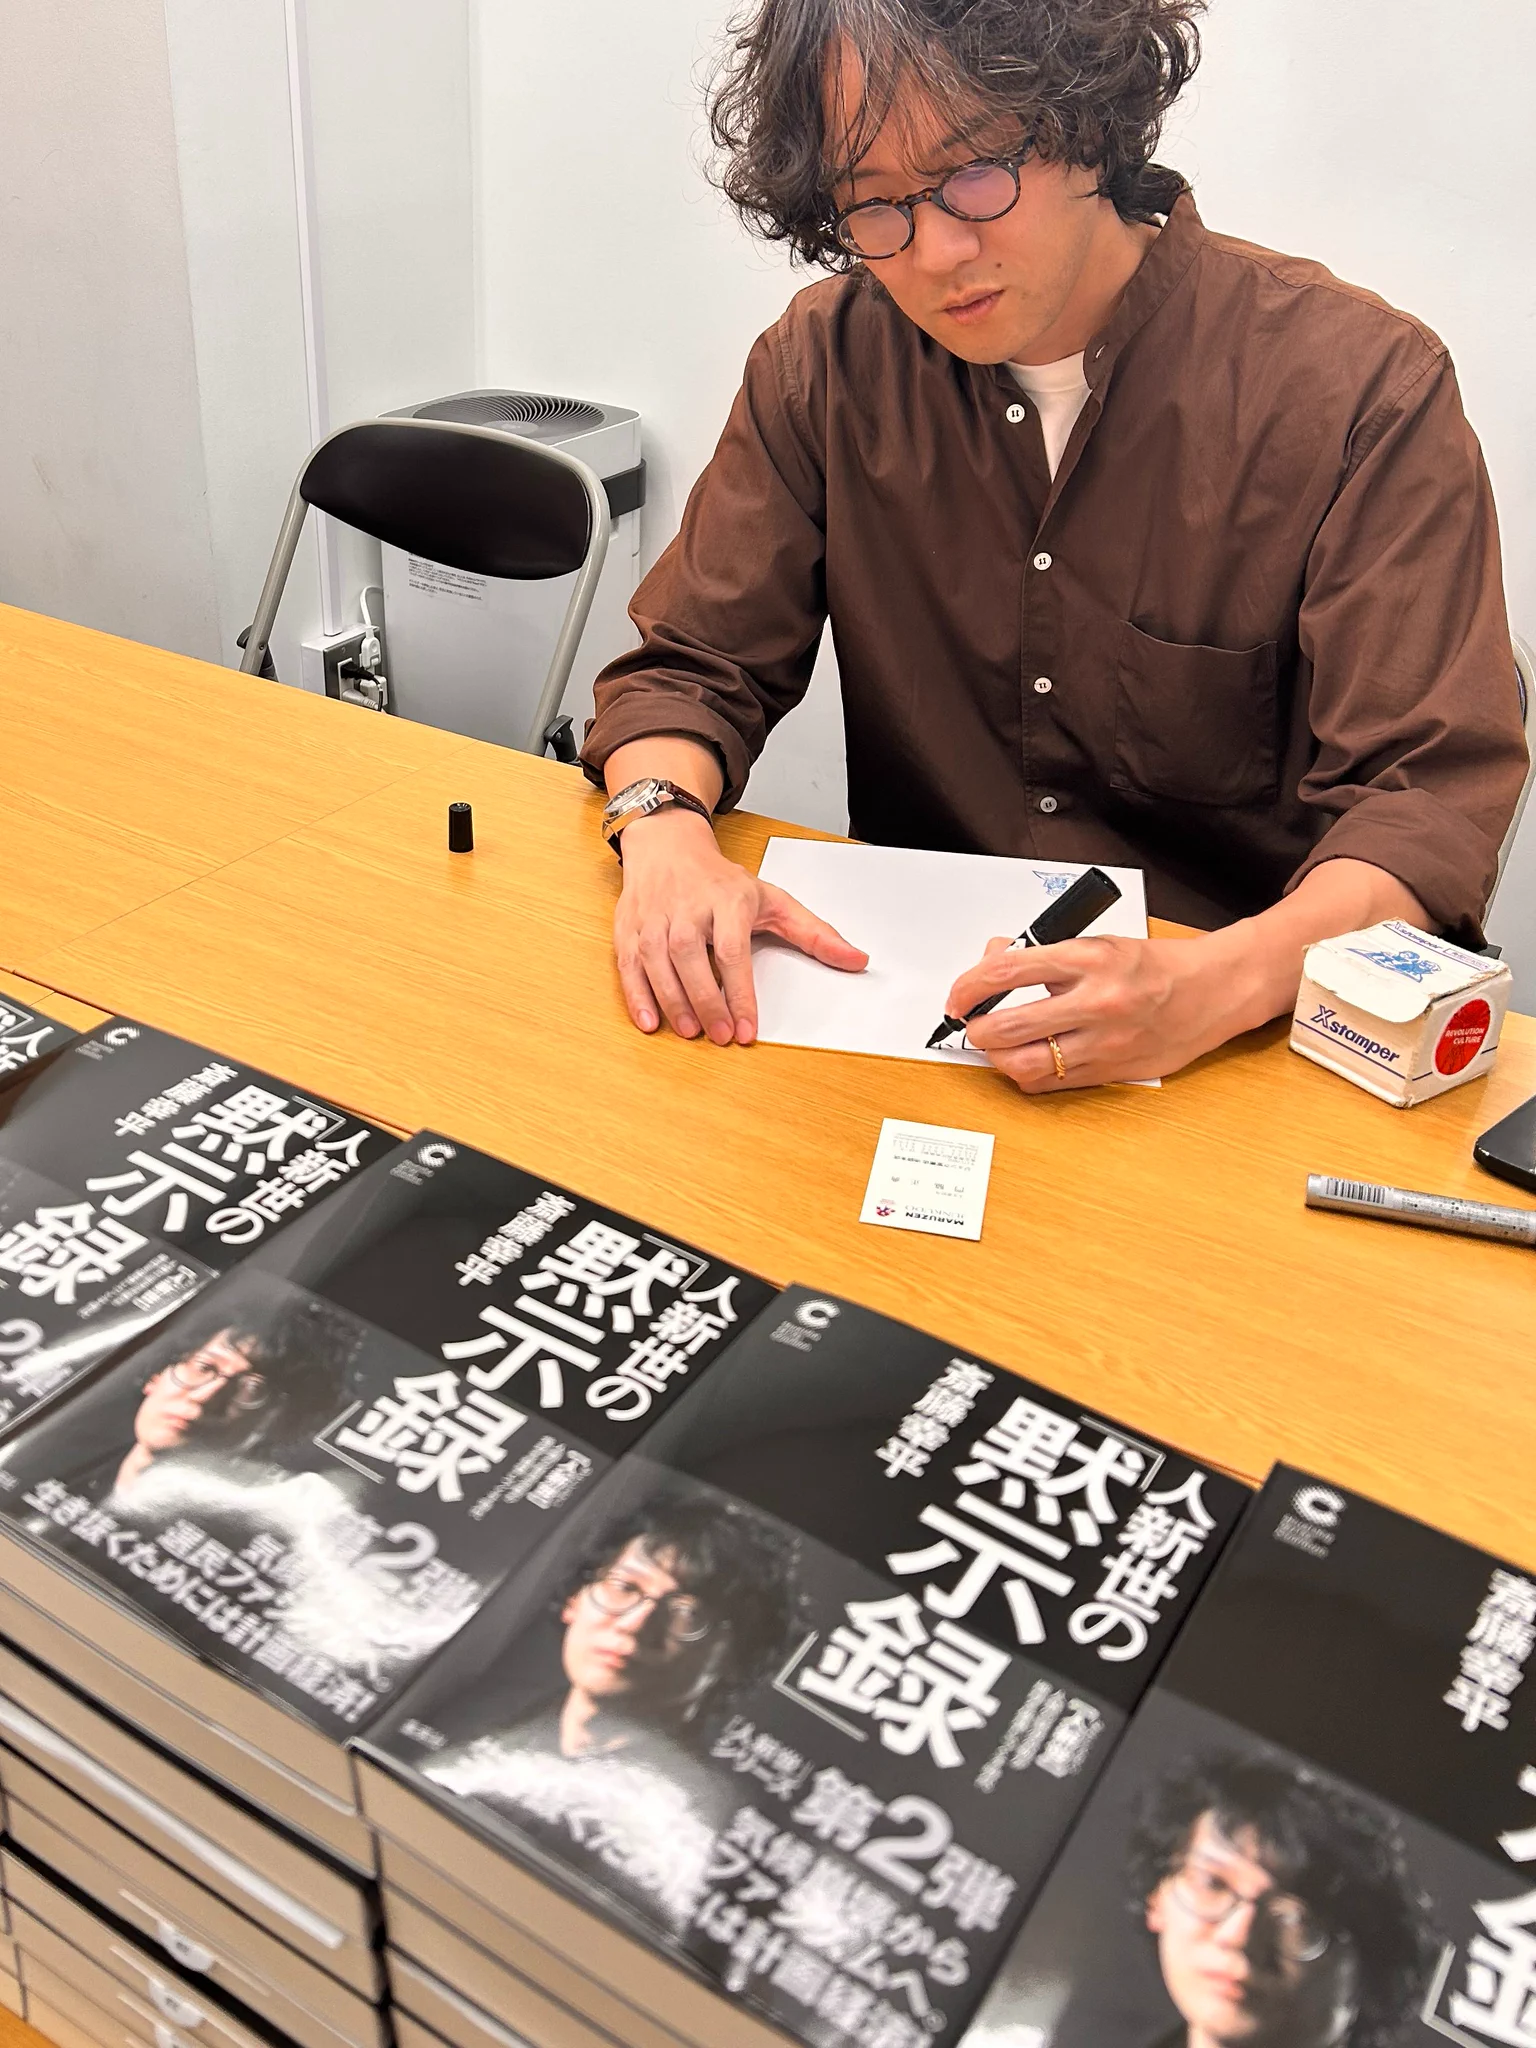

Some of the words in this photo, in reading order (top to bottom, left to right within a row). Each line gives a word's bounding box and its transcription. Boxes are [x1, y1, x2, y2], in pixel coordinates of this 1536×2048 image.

[1310, 1003, 1401, 1064] Xstamper
[1445, 1027, 1485, 1038] REVOLUTION
[1453, 1035, 1482, 1046] CULTURE
[0, 1084, 347, 1305] 「黙示録
[204, 1129, 373, 1246] 人新世の
[904, 1212, 965, 1226] MARUZEN
[312, 1219, 710, 1502] 「黙示録」
[585, 1275, 742, 1422] 人新世の
[771, 1394, 1168, 1770] 「黙示録」
[1066, 1468, 1219, 1663] 人新世の
[790, 1765, 1018, 1933] 第2弾
